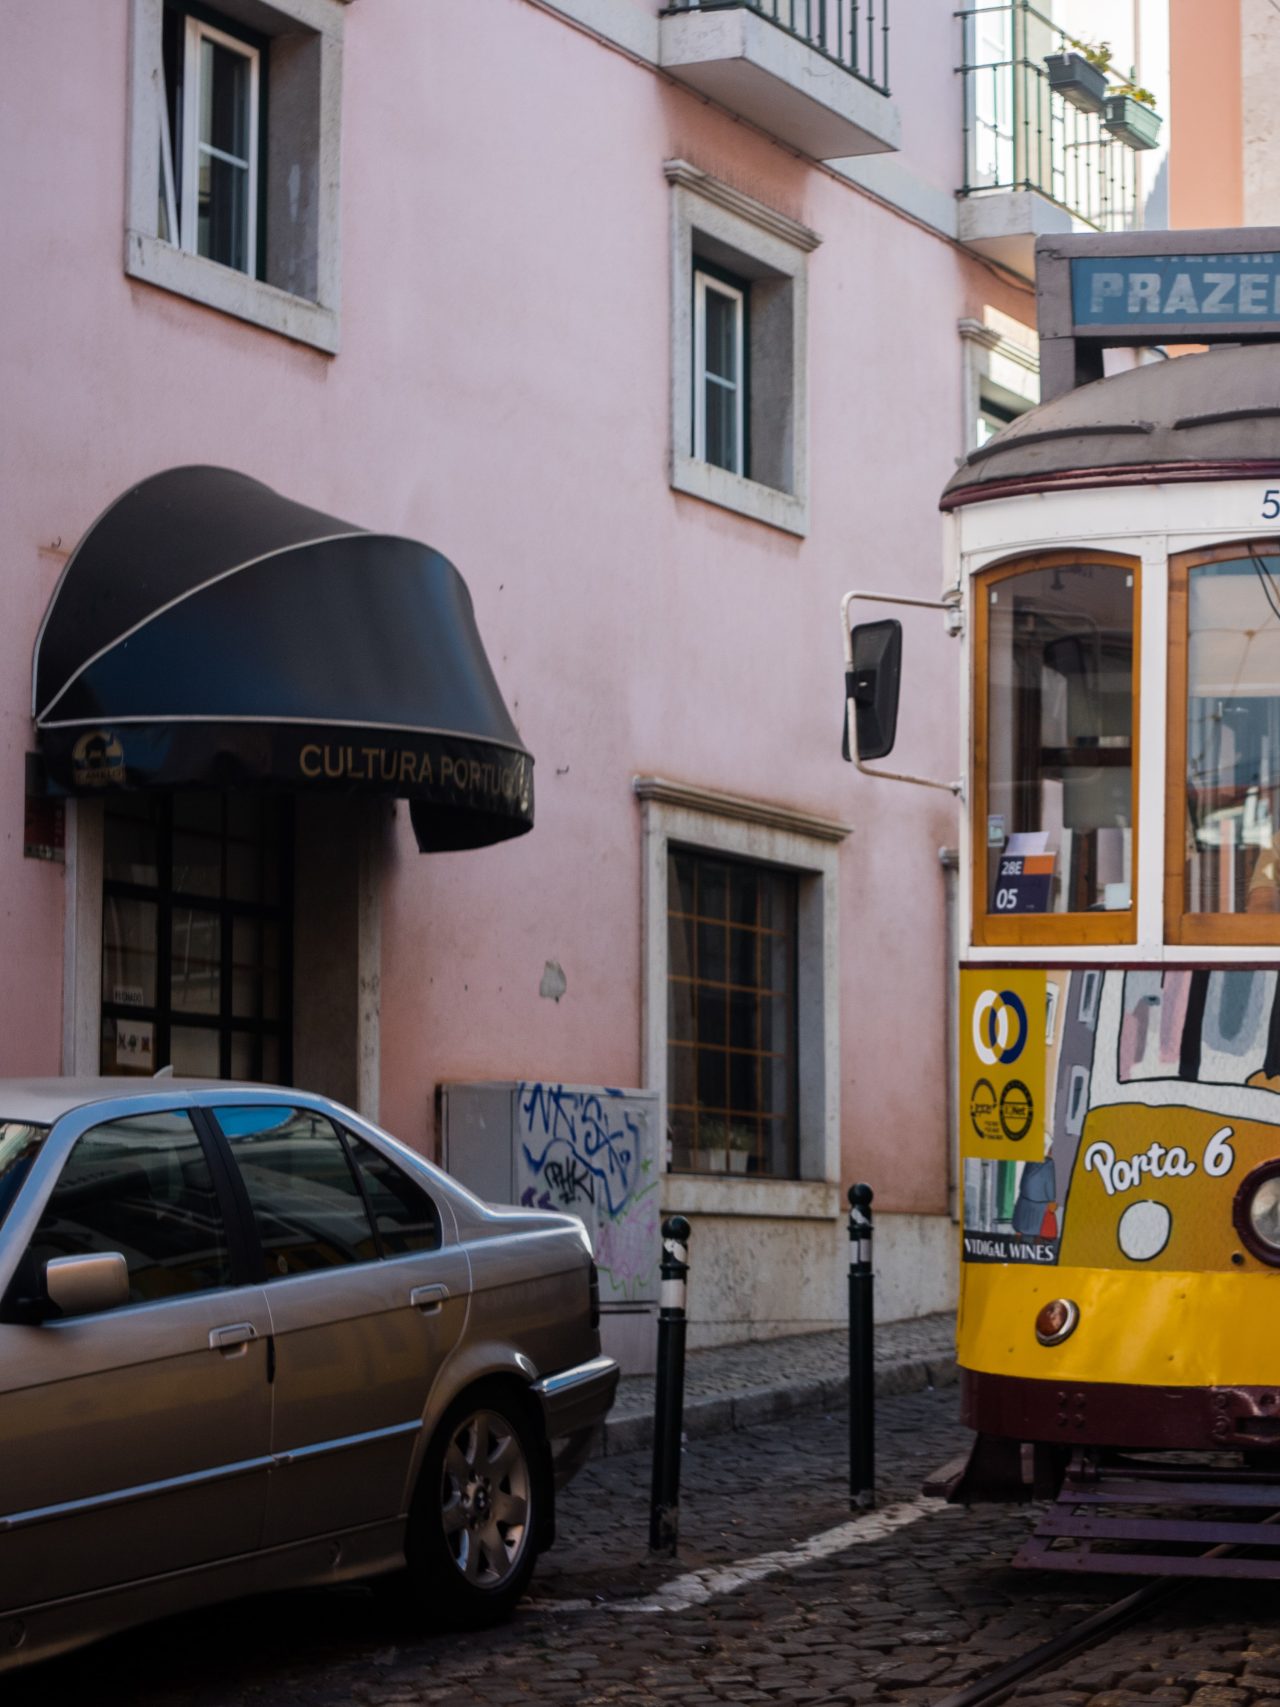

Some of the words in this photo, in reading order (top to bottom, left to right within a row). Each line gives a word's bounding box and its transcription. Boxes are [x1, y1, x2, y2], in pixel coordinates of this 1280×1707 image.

[299, 744, 434, 785] CULTURA
[1001, 861, 1022, 876] 28E
[996, 888, 1018, 909] 05
[1085, 1140, 1197, 1195] Porta
[1203, 1126, 1235, 1177] 6
[964, 1238, 1007, 1258] VIDIGAL
[1009, 1242, 1054, 1262] WINES
